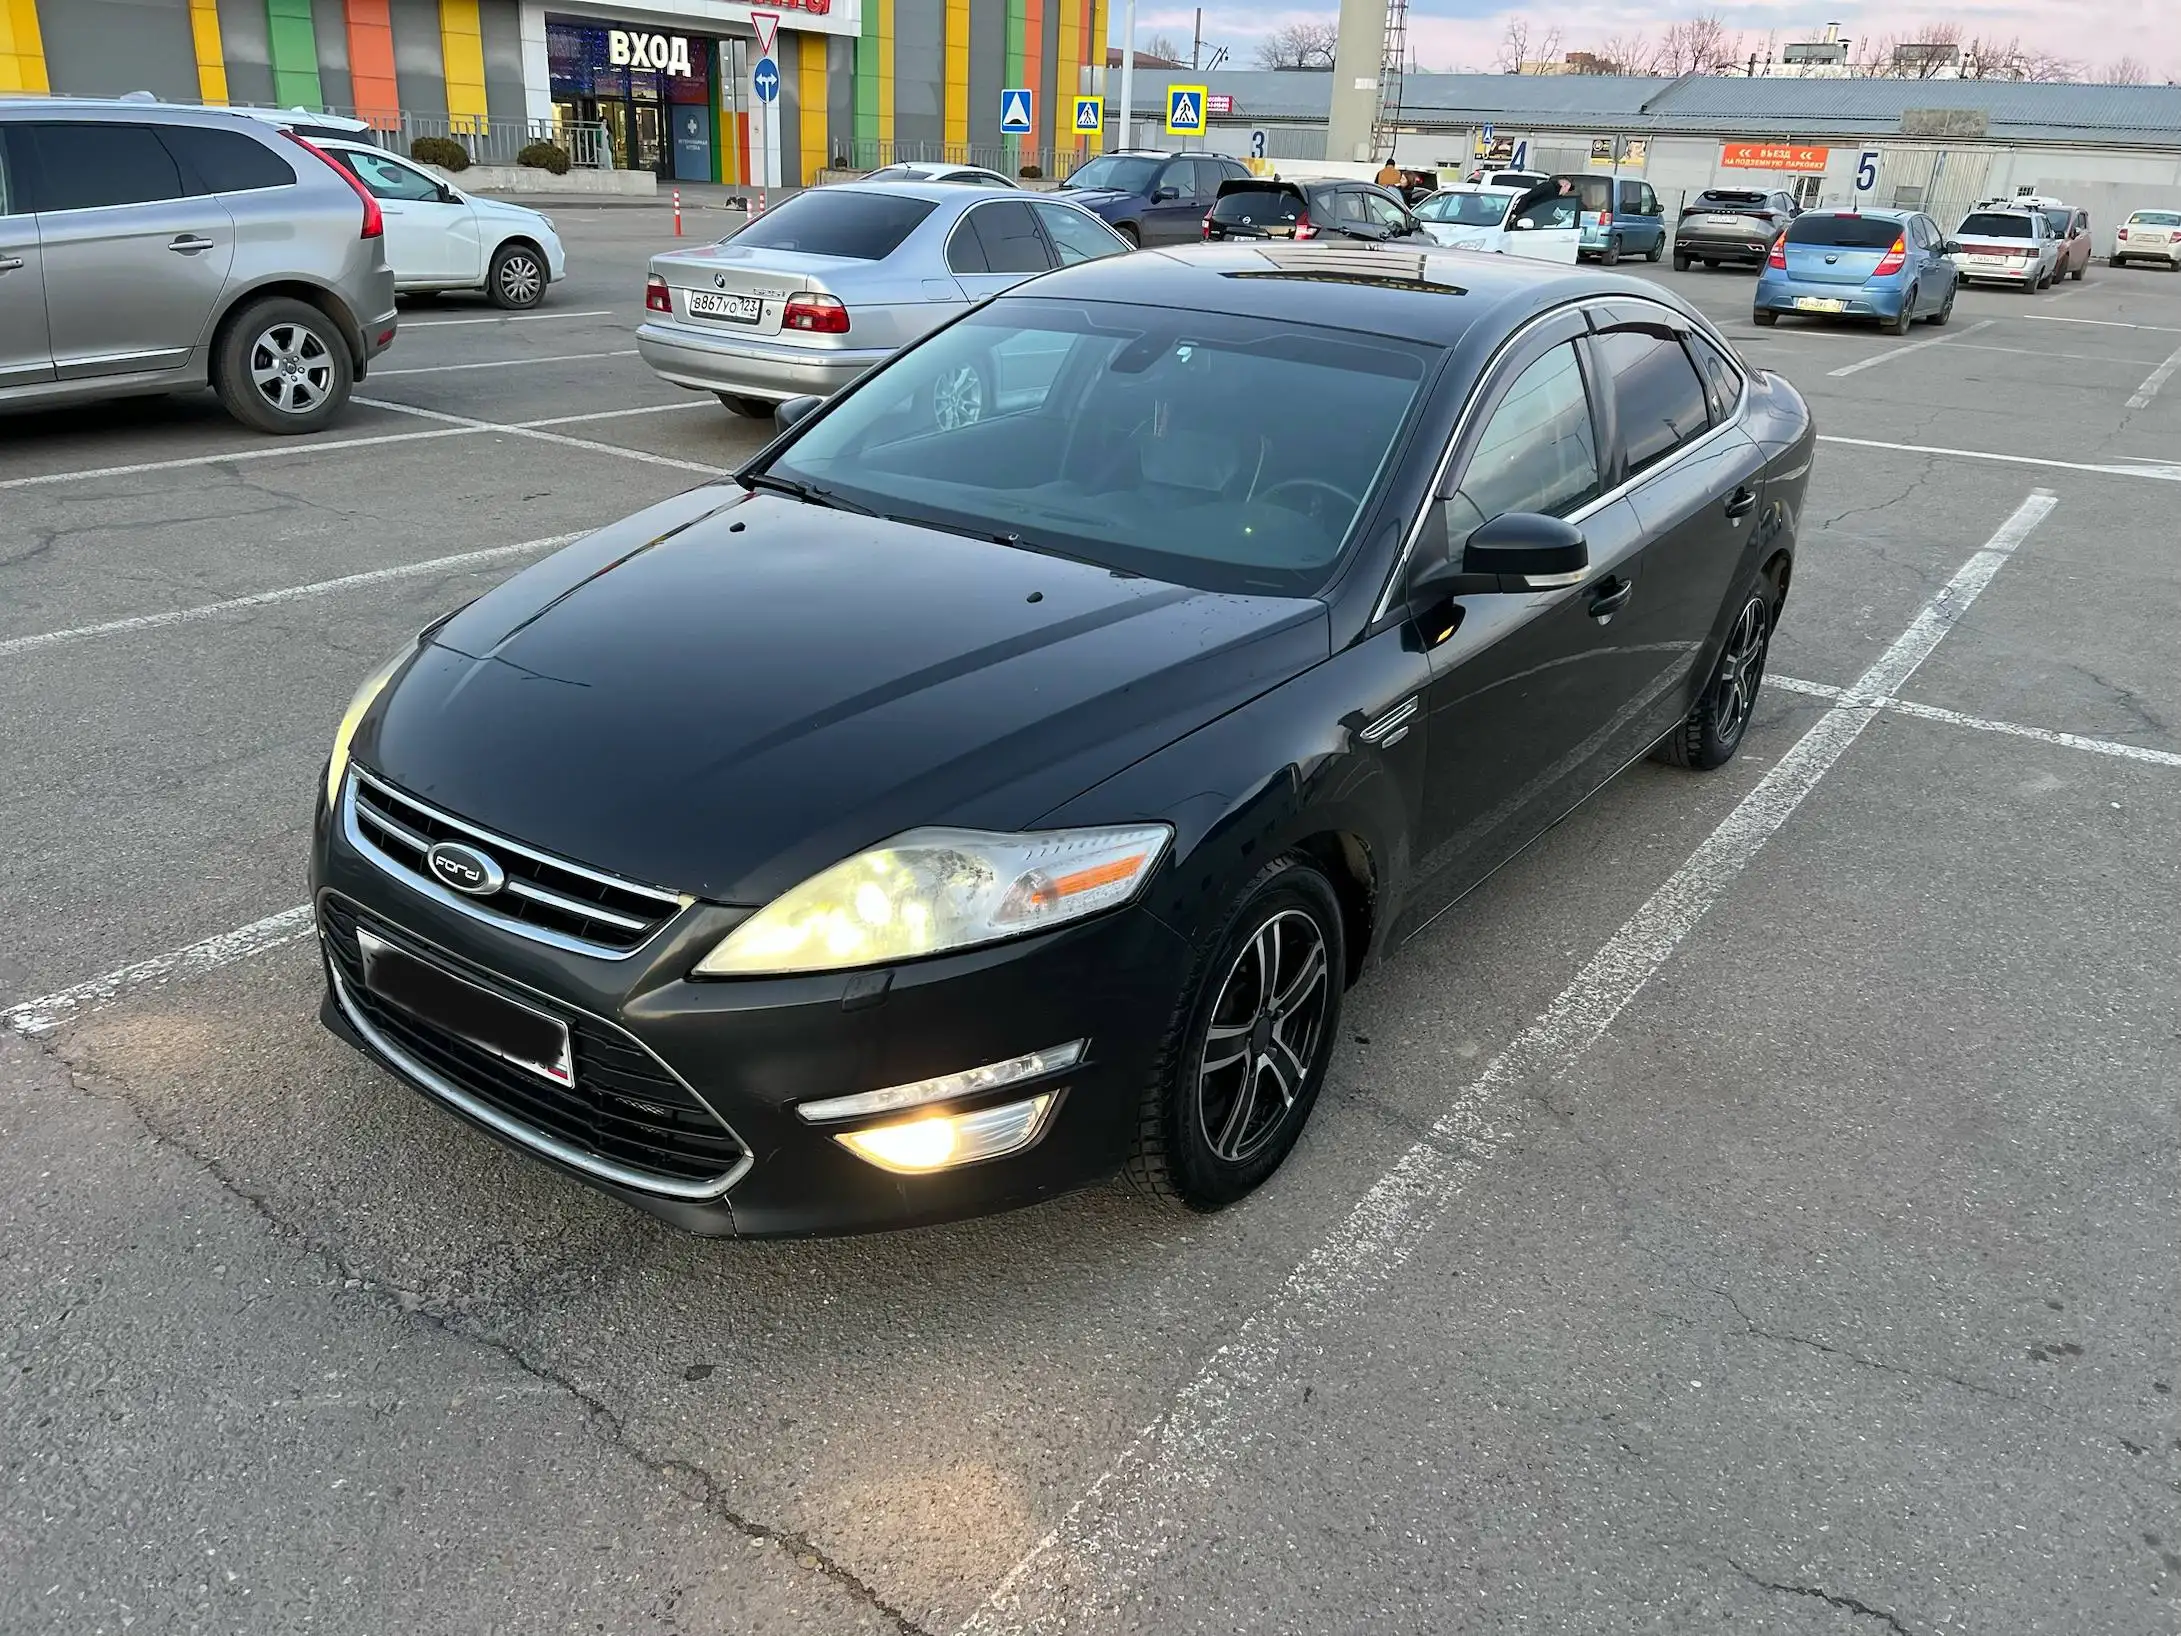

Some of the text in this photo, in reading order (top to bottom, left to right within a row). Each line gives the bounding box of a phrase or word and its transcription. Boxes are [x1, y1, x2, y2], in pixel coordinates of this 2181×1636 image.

[608, 30, 692, 77] ВХОД
[1252, 131, 1265, 159] 3
[1510, 141, 1527, 172] 4
[1760, 149, 1792, 159] ВЪЕЗД
[1725, 157, 1825, 169] НА ПОДЗЕМНУЮ ПАРКОВКУ
[1856, 152, 1879, 191] 5
